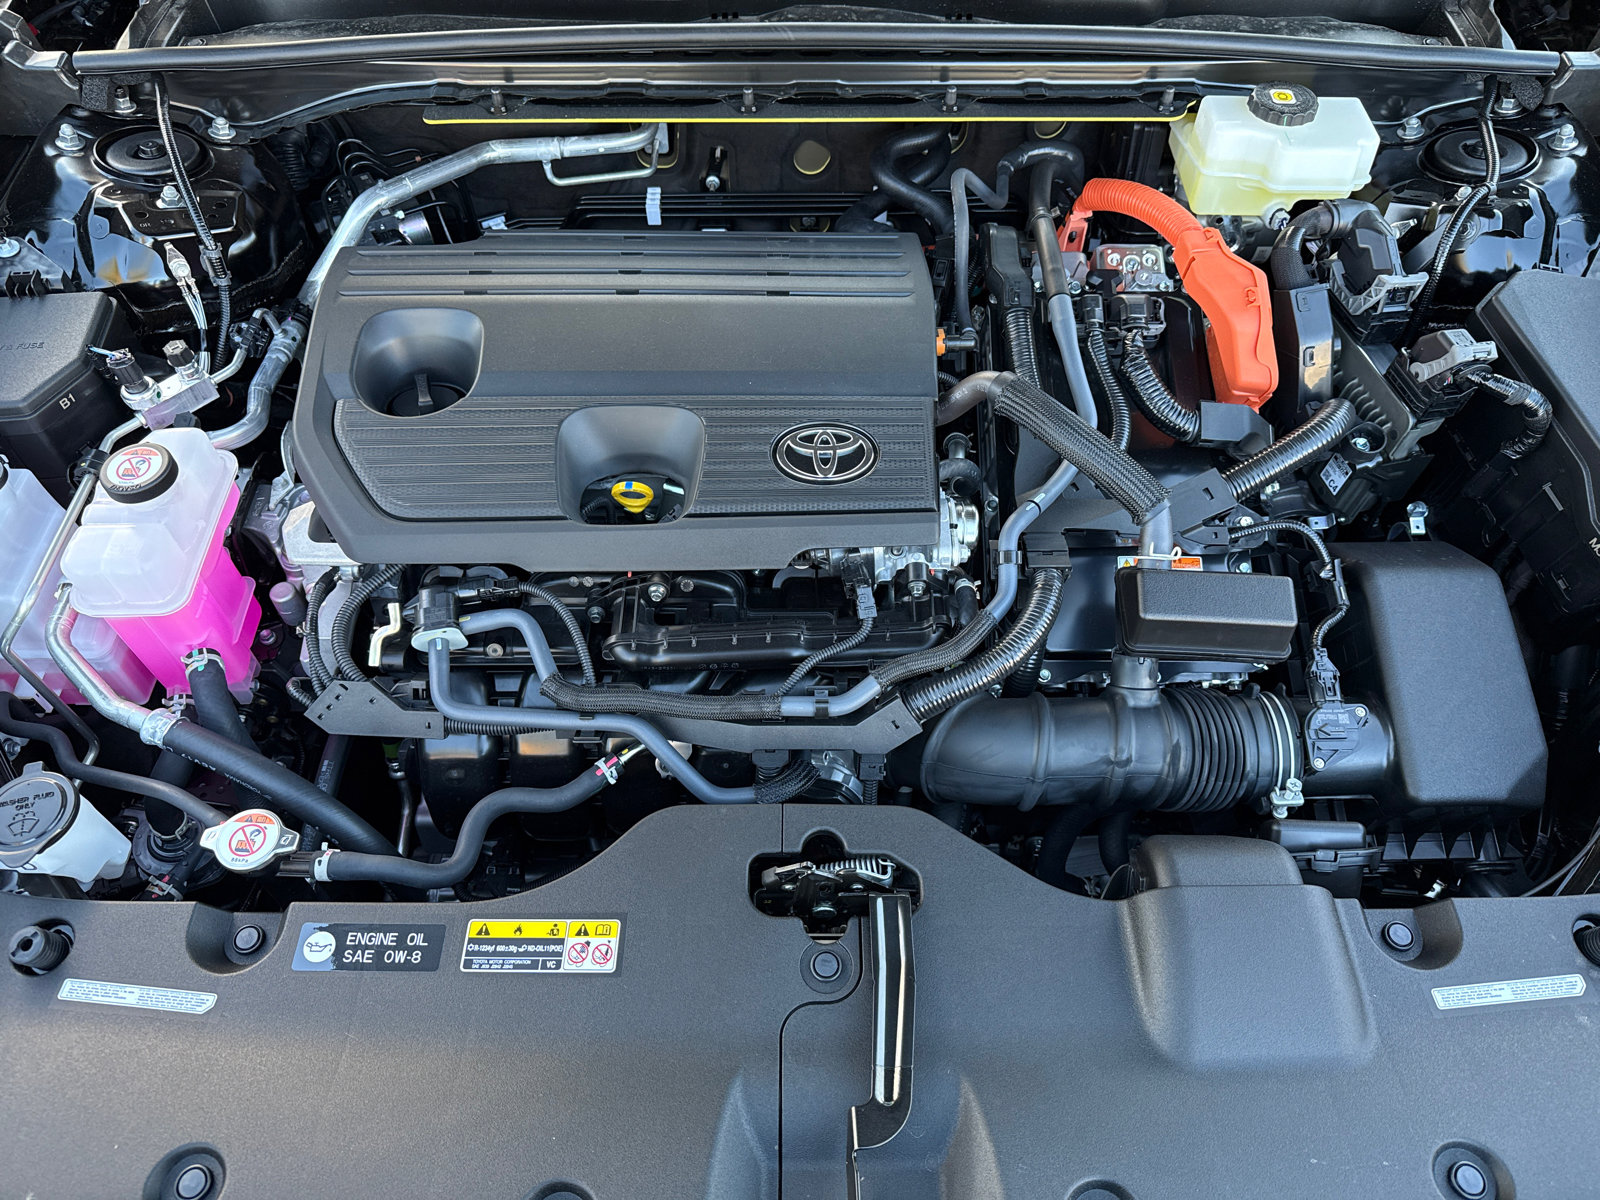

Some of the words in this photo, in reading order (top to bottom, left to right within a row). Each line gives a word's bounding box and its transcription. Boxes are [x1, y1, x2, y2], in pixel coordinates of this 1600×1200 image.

[16, 342, 44, 350] FUSE
[59, 393, 76, 410] B1
[346, 932, 399, 946] ENGINE
[406, 932, 429, 946] OIL
[342, 950, 375, 963] SAE
[384, 950, 422, 964] 0W-8
[546, 960, 557, 968] VC
